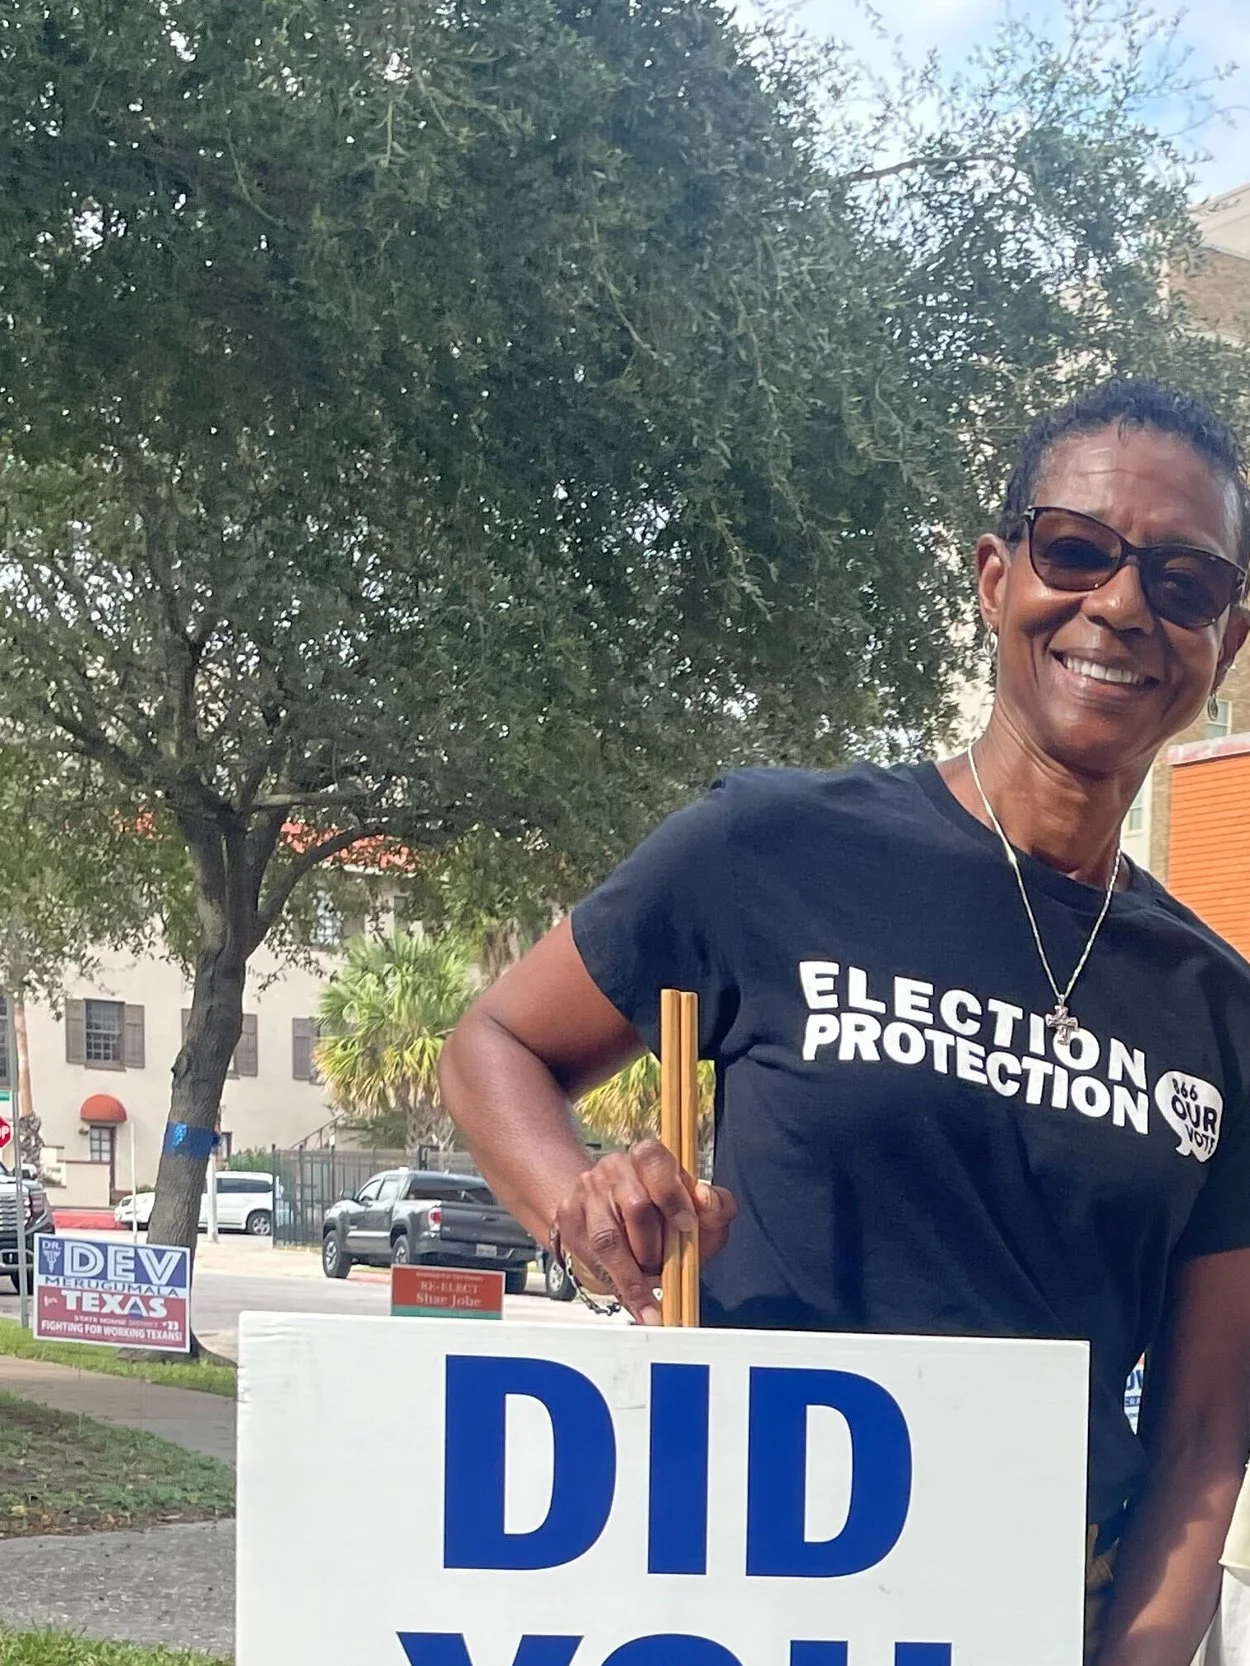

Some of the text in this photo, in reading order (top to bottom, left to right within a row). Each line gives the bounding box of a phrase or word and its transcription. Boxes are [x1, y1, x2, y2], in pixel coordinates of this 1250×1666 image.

[799, 960, 1147, 1091] ELECTION
[802, 1012, 1149, 1136] PROTECTION
[1170, 1094, 1218, 1136] OUR
[63, 1240, 183, 1286] DEV
[44, 1275, 180, 1297] MERUGUMALA
[61, 1289, 168, 1319] TEXAS
[420, 1280, 480, 1294] RE-ELECT
[451, 1293, 481, 1309] Jobe
[41, 1319, 84, 1334] FIGHTING
[84, 1323, 104, 1336] FOR
[103, 1325, 146, 1340] WORKING
[444, 1356, 911, 1577] DID
